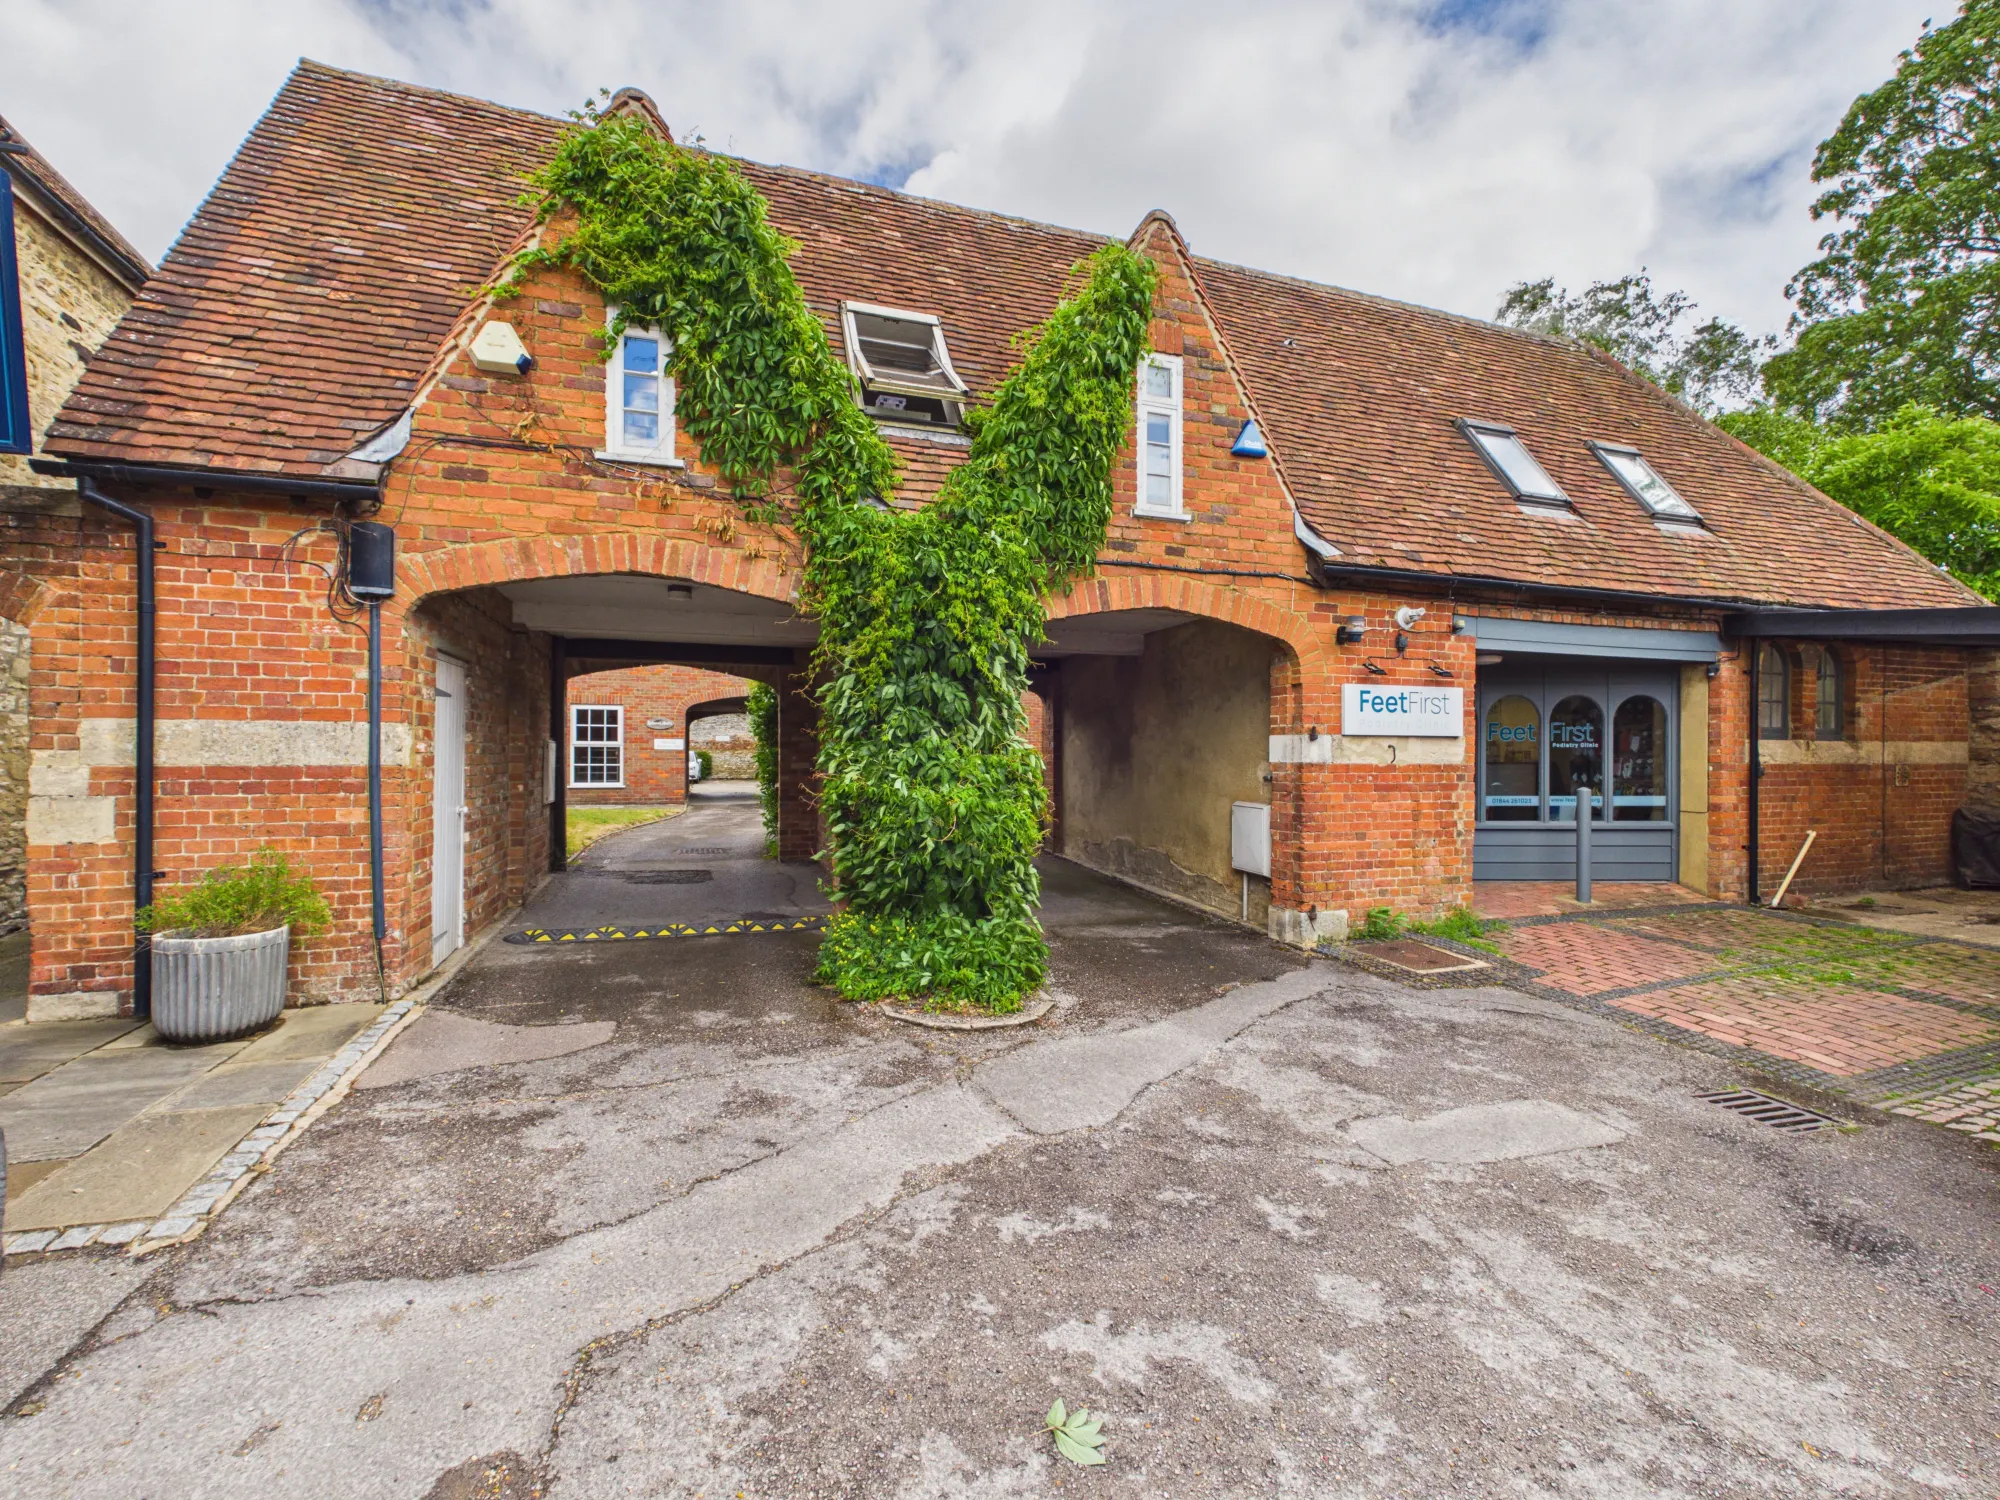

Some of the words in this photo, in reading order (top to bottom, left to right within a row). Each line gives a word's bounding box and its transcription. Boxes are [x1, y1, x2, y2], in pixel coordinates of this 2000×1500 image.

[1415, 719, 1450, 731] Clinic
[1488, 722, 1536, 742] Feet
[1550, 721, 1594, 742] First
